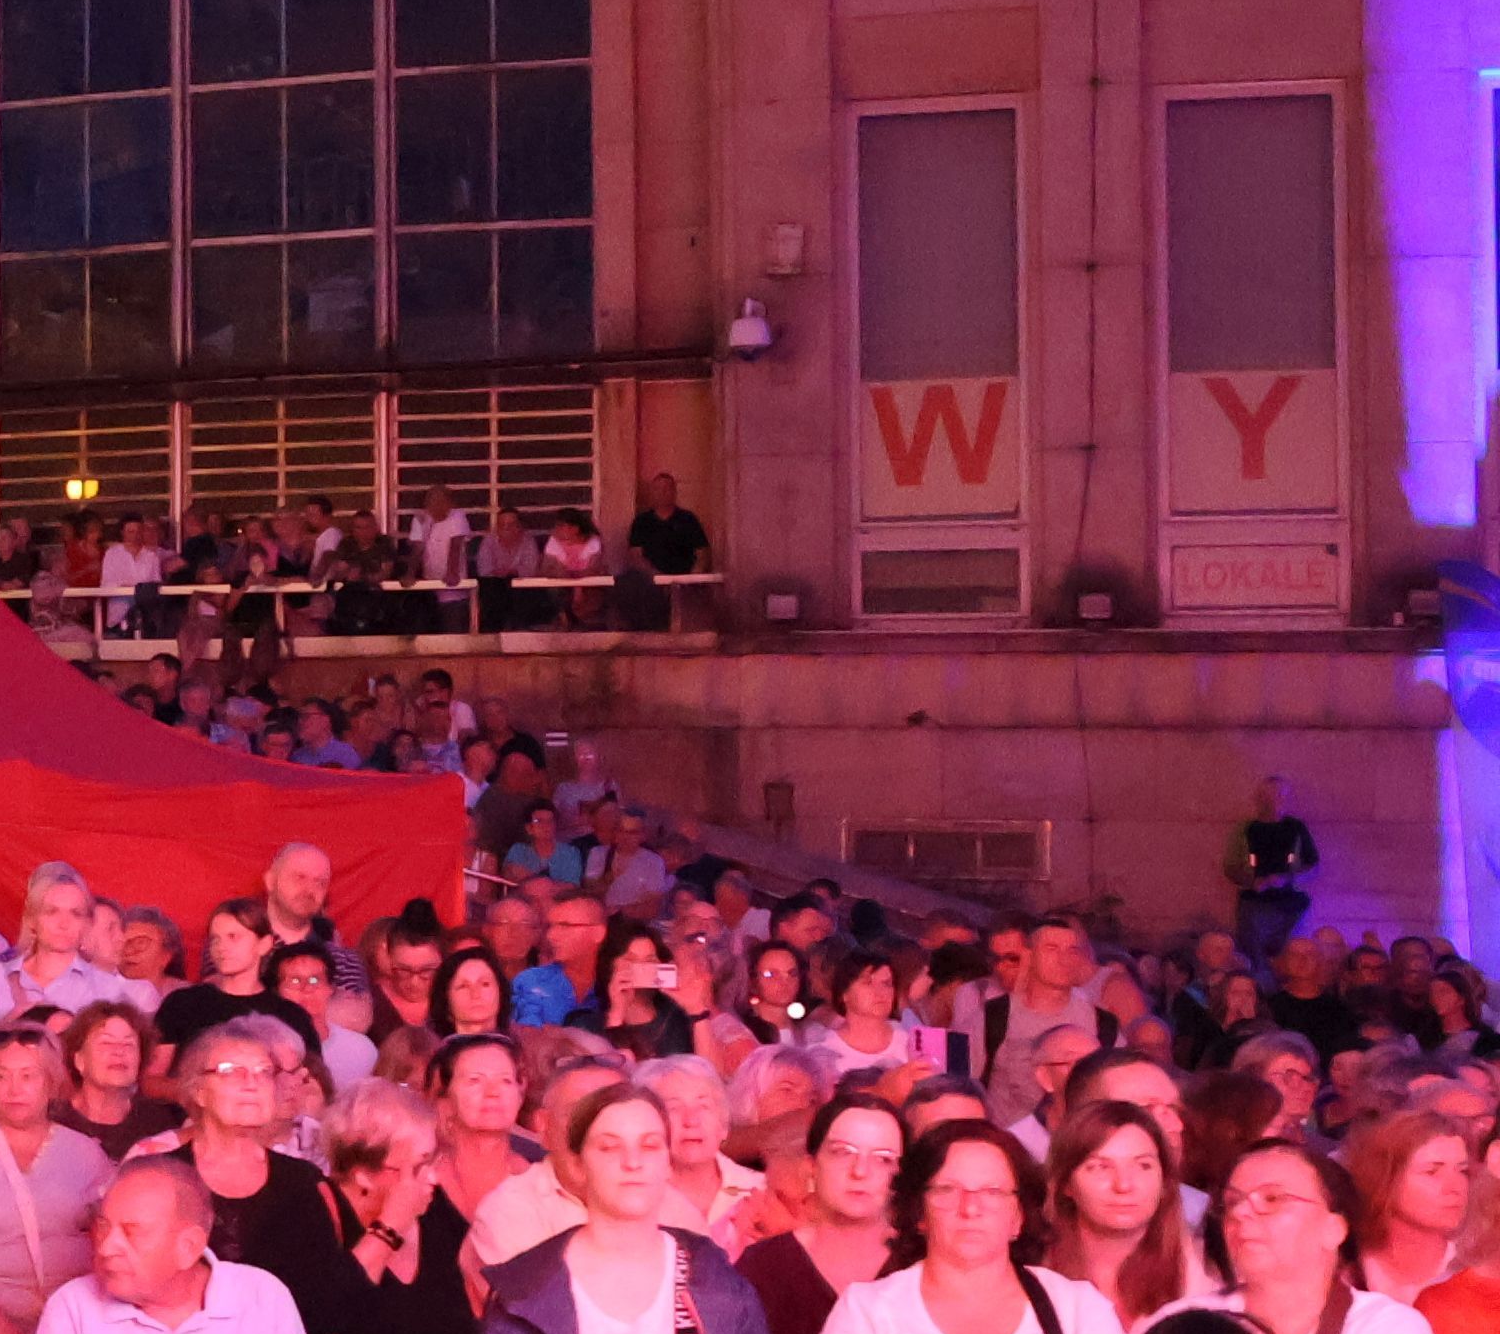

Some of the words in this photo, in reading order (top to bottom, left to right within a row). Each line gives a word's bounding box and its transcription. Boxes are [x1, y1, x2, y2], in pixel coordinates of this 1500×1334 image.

[869, 381, 1008, 487] W
[1200, 375, 1306, 480] Y
[1182, 558, 1328, 591] LOKALE
